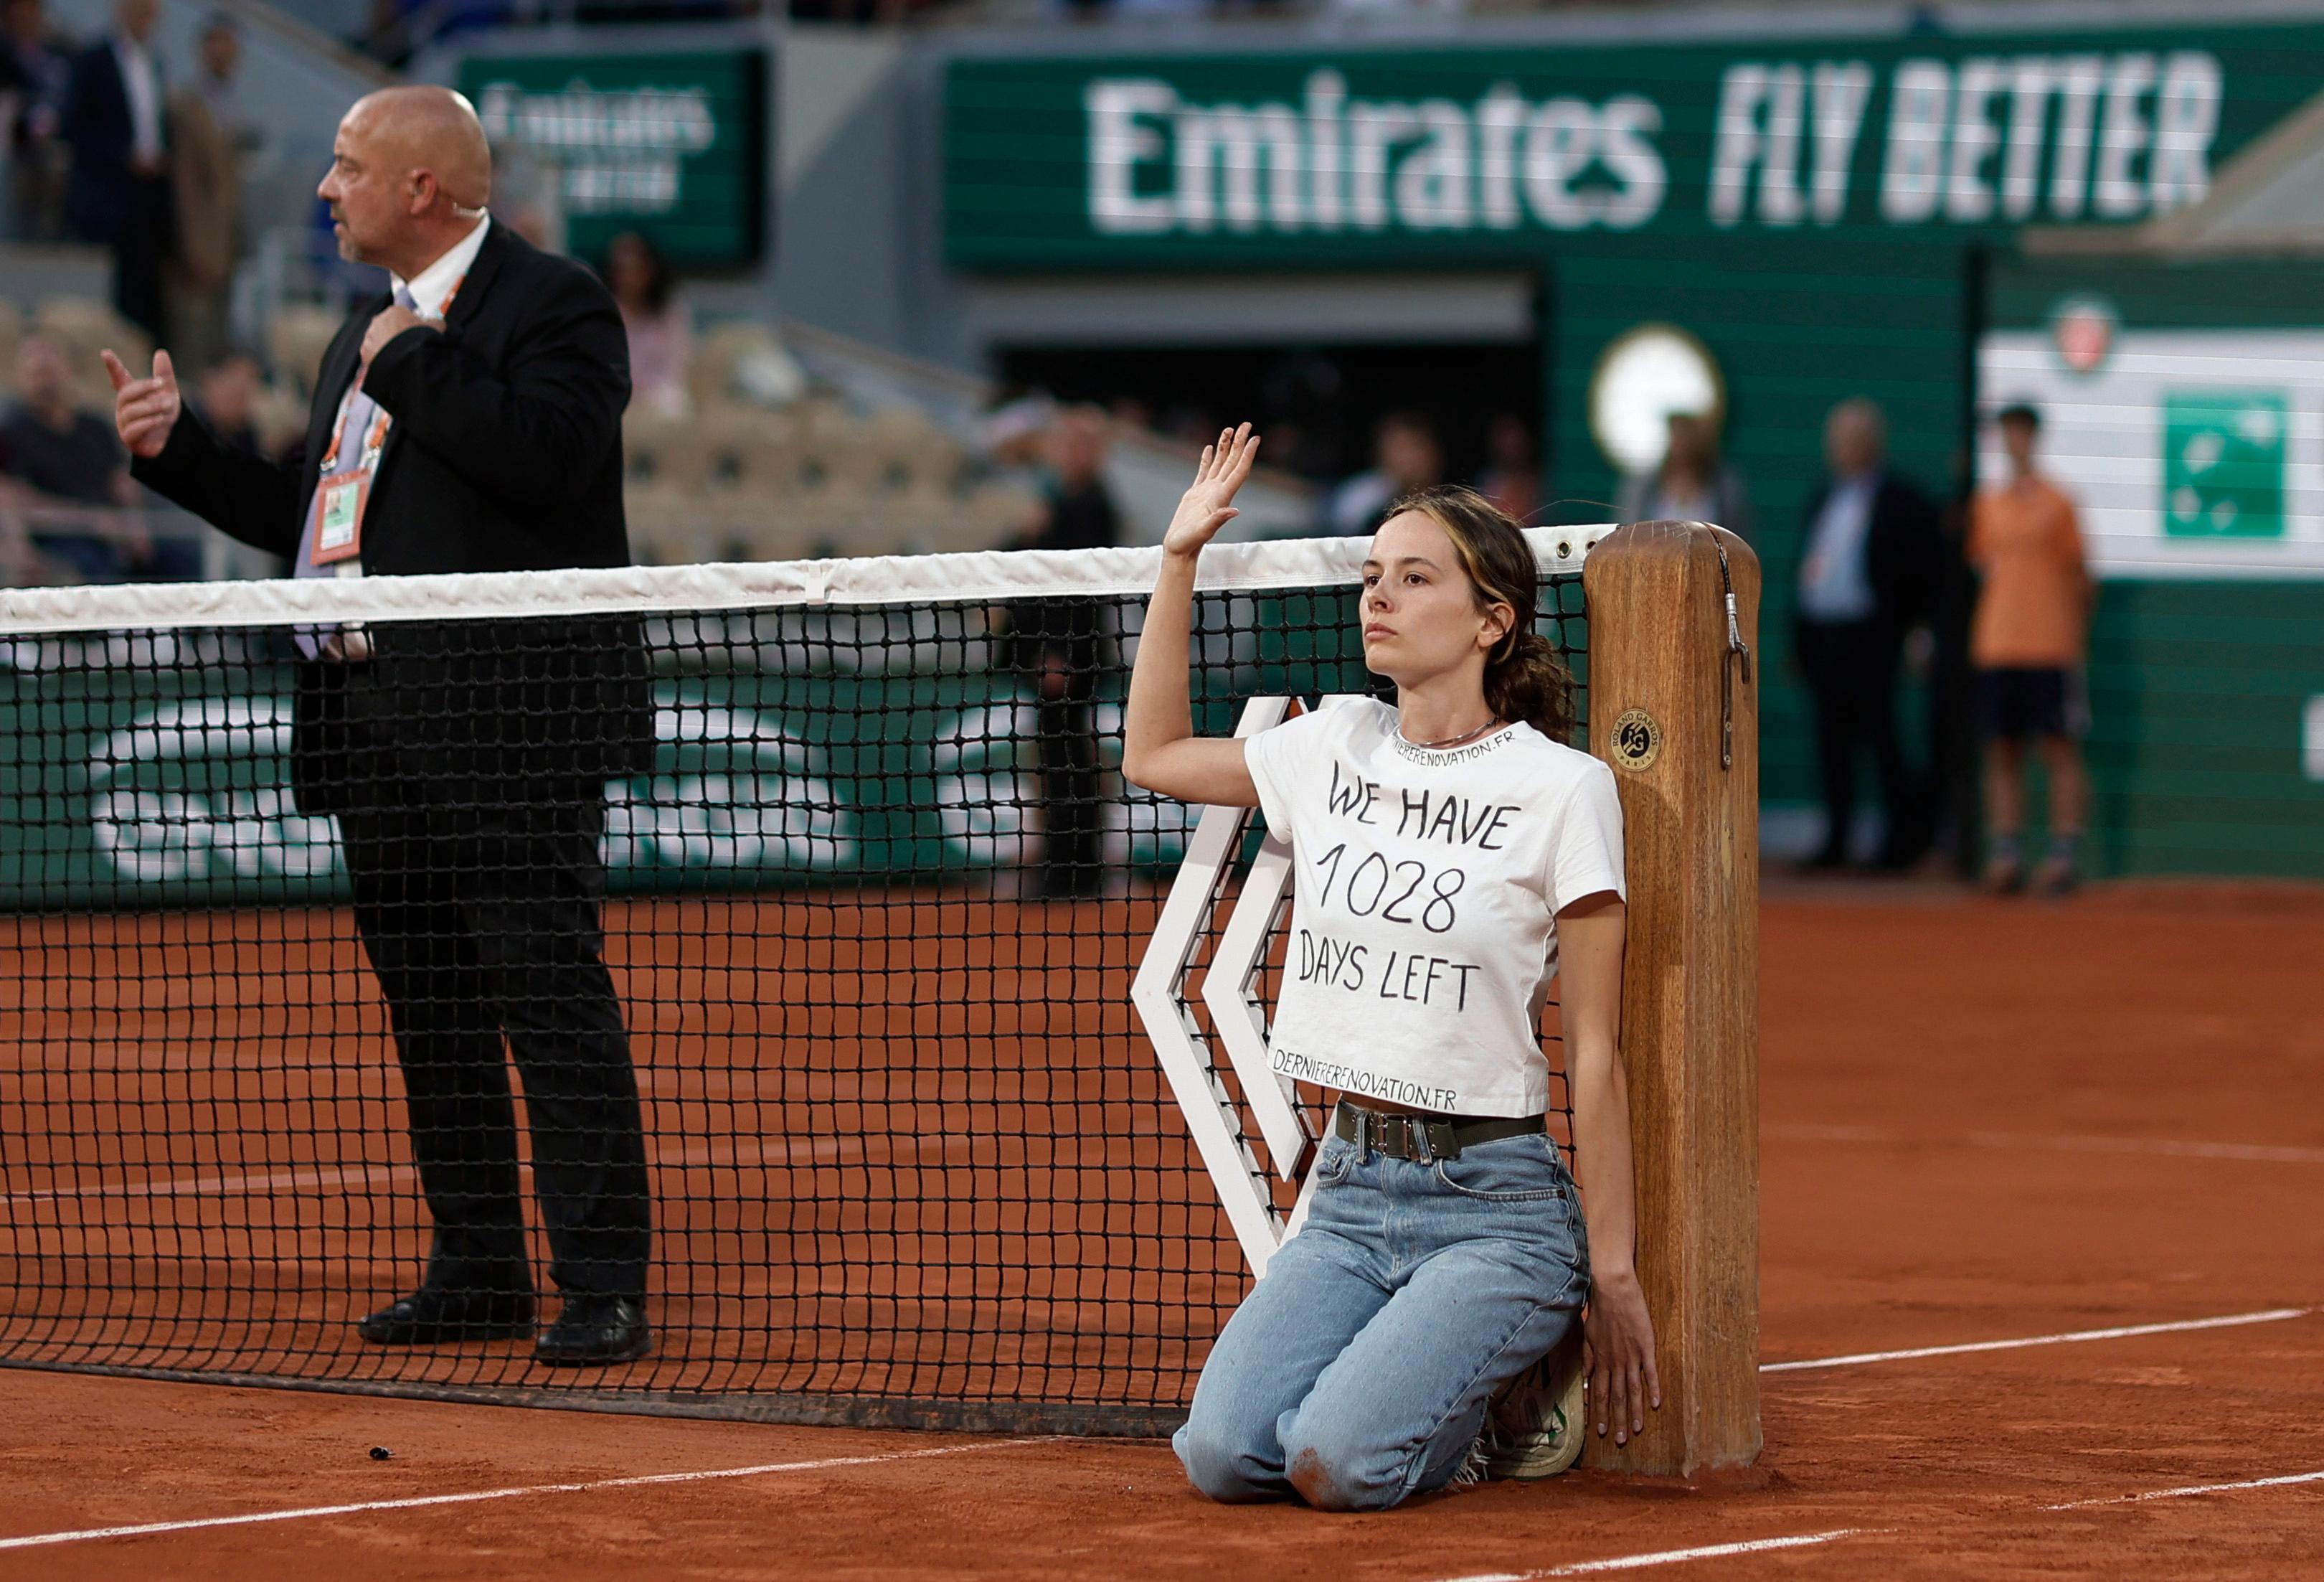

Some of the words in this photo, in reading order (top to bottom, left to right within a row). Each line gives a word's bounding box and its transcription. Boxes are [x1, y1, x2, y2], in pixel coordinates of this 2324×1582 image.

[1088, 67, 1666, 234] Emirates
[1709, 62, 1872, 226] FLY
[1881, 51, 2220, 222] BETTER
[1612, 712, 1634, 747] ROLAND
[1636, 712, 1658, 747] GARROS
[1329, 760, 1380, 824] WE
[1397, 788, 1522, 850] HAVE
[1316, 843, 1465, 933] 1028
[1299, 928, 1369, 991] DAYS
[1380, 951, 1482, 1013] LEFT
[1272, 1048, 1458, 1111] DERNIERERENOVATION.FR
